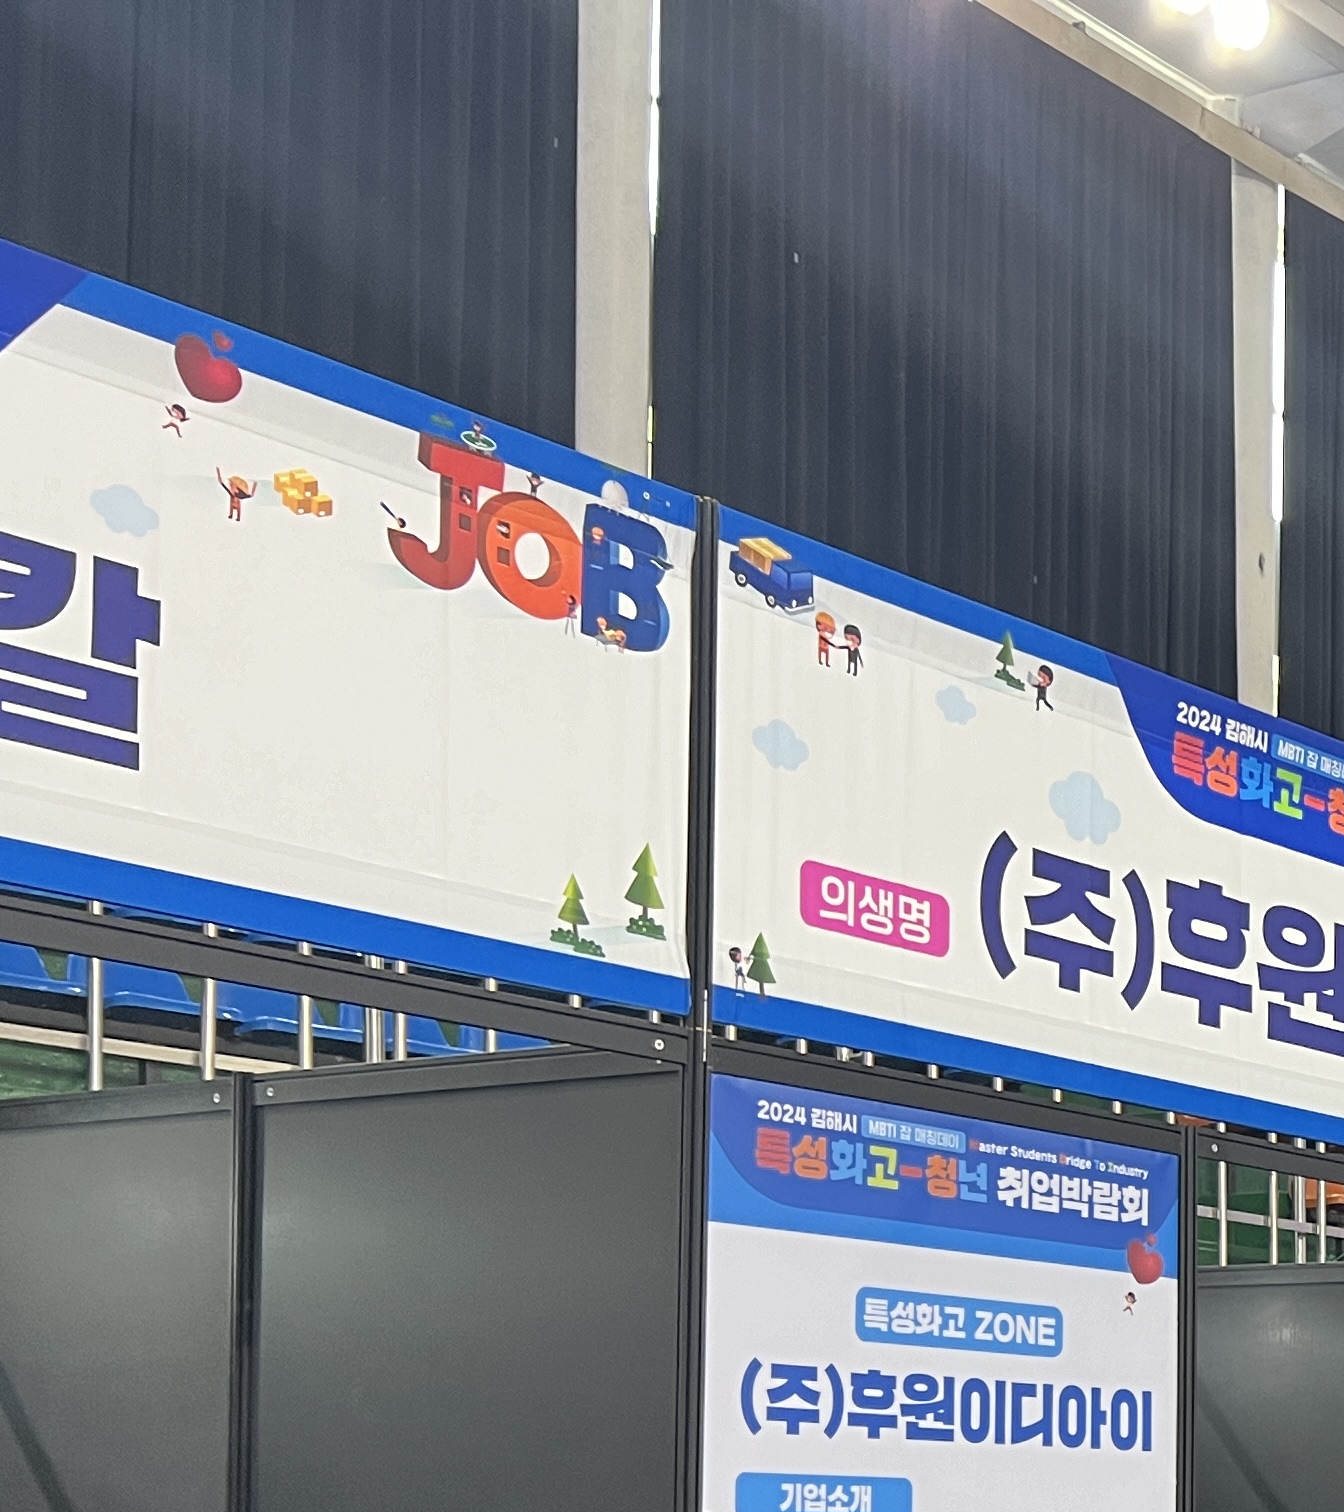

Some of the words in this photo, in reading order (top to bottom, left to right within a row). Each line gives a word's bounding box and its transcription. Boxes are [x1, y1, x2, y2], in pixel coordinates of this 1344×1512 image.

[386, 430, 669, 653] JOB
[1176, 701, 1222, 736] 2024
[1225, 718, 1269, 754] 김해시
[1277, 739, 1305, 765] MBTI
[1306, 749, 1319, 770] 잡
[819, 872, 934, 946] 의생명
[755, 1127, 989, 1204] 특성화고-청년
[997, 1165, 1149, 1227] 취업박람회
[756, 1099, 807, 1126] 2024
[809, 1107, 858, 1135] 김해시
[867, 1118, 897, 1140] MBTI
[899, 1124, 912, 1142] 잡
[914, 1127, 961, 1151] 매칭데이
[1010, 1145, 1058, 1164] Students
[1107, 1161, 1149, 1180] Industry
[862, 1296, 967, 1340] 특성화고
[973, 1311, 1057, 1348] ZONE
[740, 1356, 1154, 1453] (주)후원이디아이
